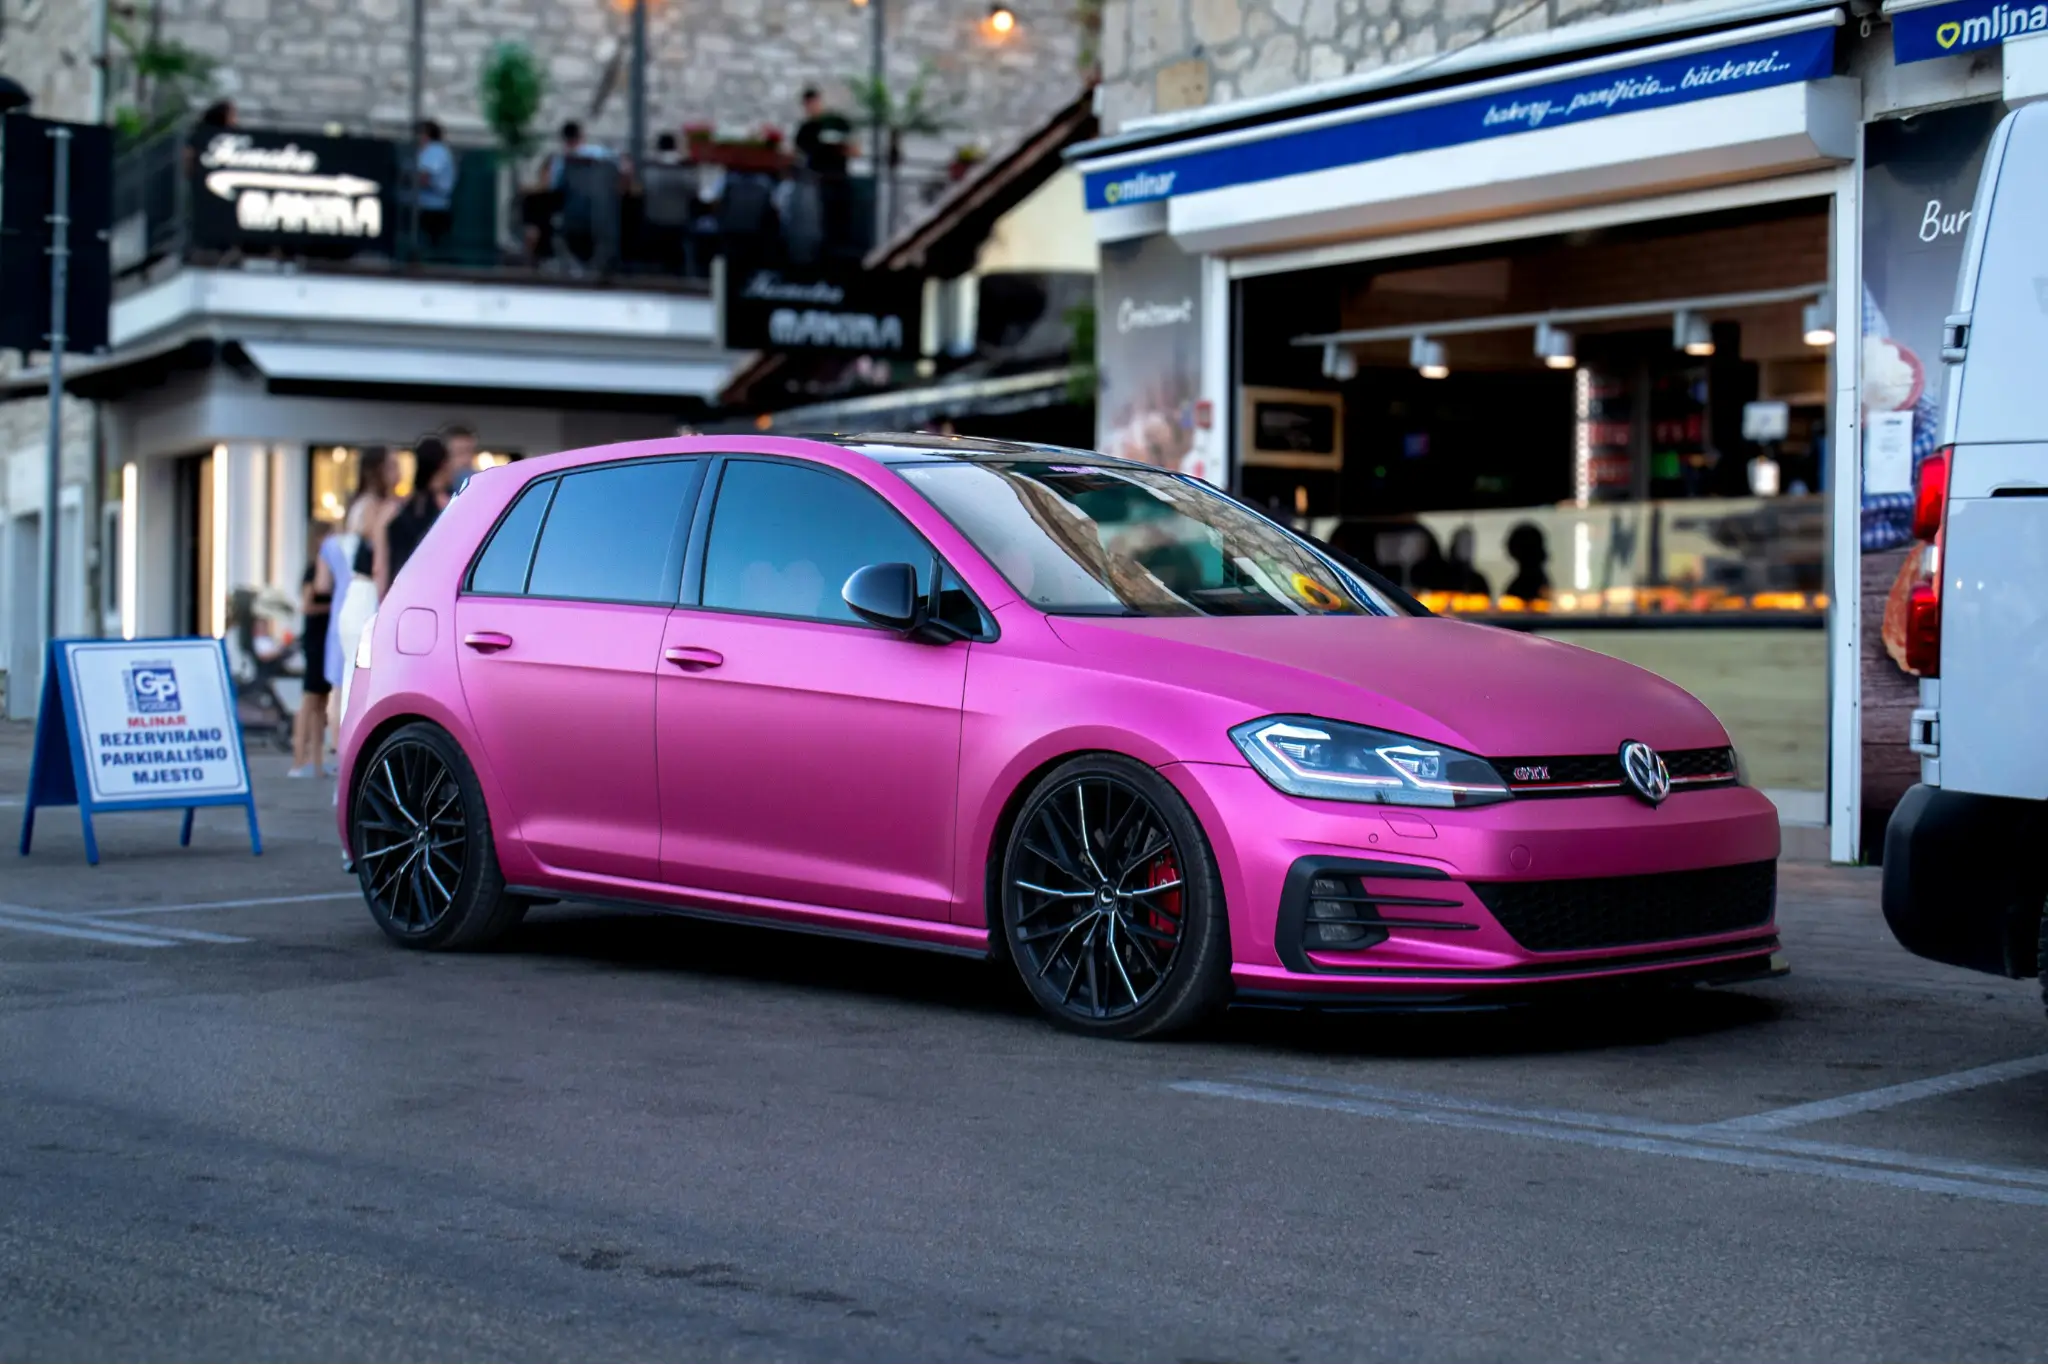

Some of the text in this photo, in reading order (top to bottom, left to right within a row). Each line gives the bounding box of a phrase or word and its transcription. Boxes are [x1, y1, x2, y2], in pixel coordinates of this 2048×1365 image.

[1962, 3, 2048, 45] mlina
[1680, 50, 1790, 89] bäckerei...
[1919, 200, 1971, 242] Bur
[127, 715, 187, 728] MLINAR
[99, 728, 222, 747] REZERVIRANO
[101, 745, 228, 767] PARKIRALIŠNO
[132, 767, 204, 785] MJESTO
[1514, 766, 1550, 780] GTI
